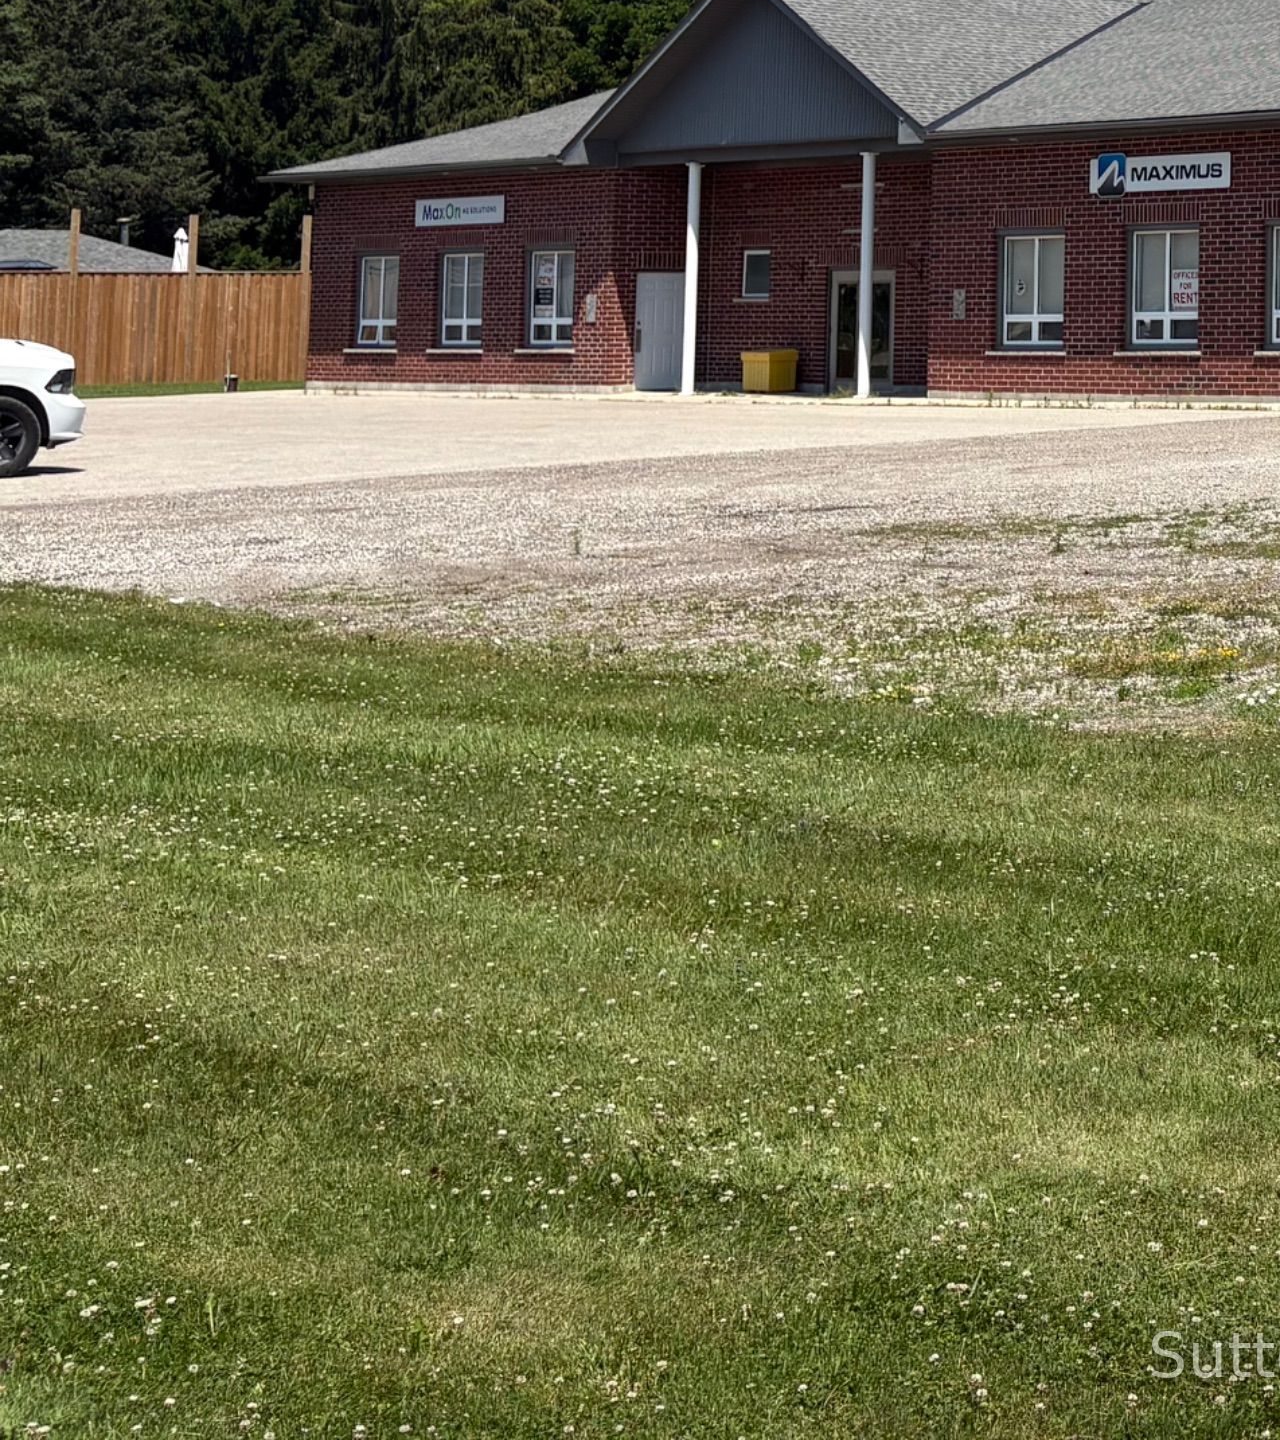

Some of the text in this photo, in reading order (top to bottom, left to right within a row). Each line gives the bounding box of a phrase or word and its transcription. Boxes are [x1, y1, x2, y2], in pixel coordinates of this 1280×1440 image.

[1131, 163, 1223, 182] MAXIMUS
[422, 203, 461, 221] MaxOn
[1173, 292, 1198, 304] RENT
